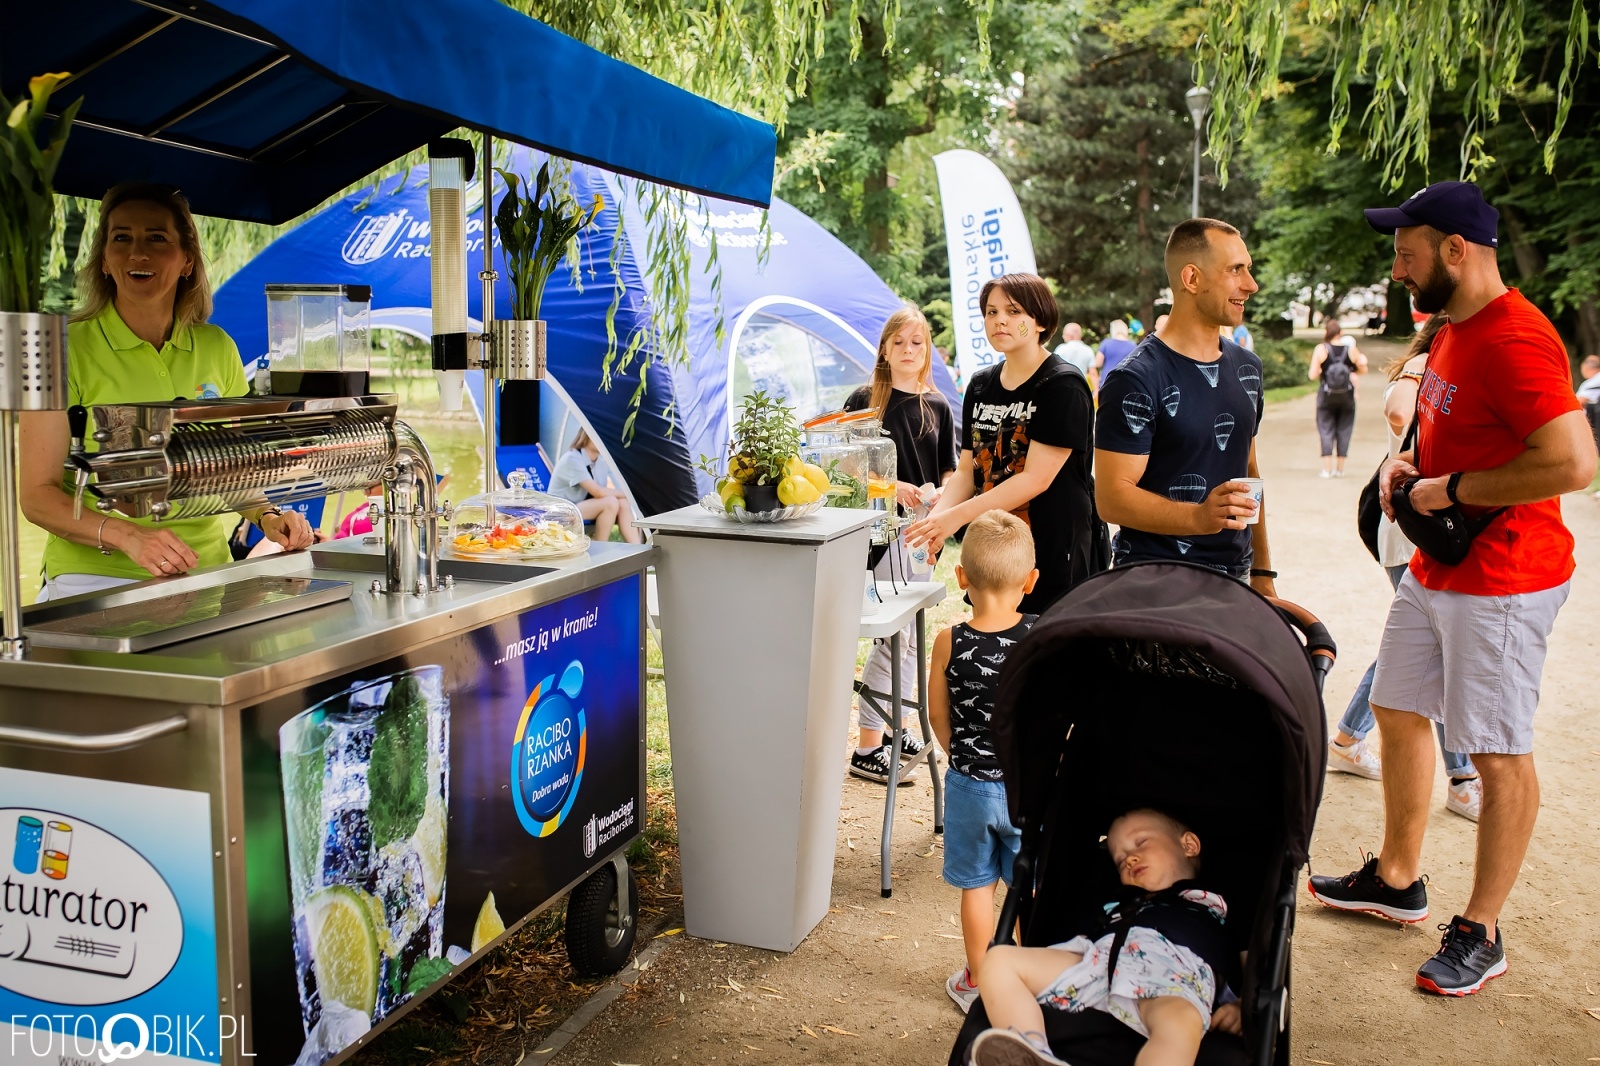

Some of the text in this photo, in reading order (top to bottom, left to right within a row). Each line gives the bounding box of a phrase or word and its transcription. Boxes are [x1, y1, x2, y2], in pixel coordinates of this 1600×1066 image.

[536, 628, 549, 653] ją
[551, 626, 561, 642] w
[563, 606, 598, 638] kranie!
[527, 717, 571, 757] RACIBO
[527, 739, 572, 779] RZANKA
[532, 773, 569, 803] Dobra woda
[598, 797, 633, 831] Wodociągi
[599, 815, 633, 845] Raciborskie
[0, 874, 148, 933] turator
